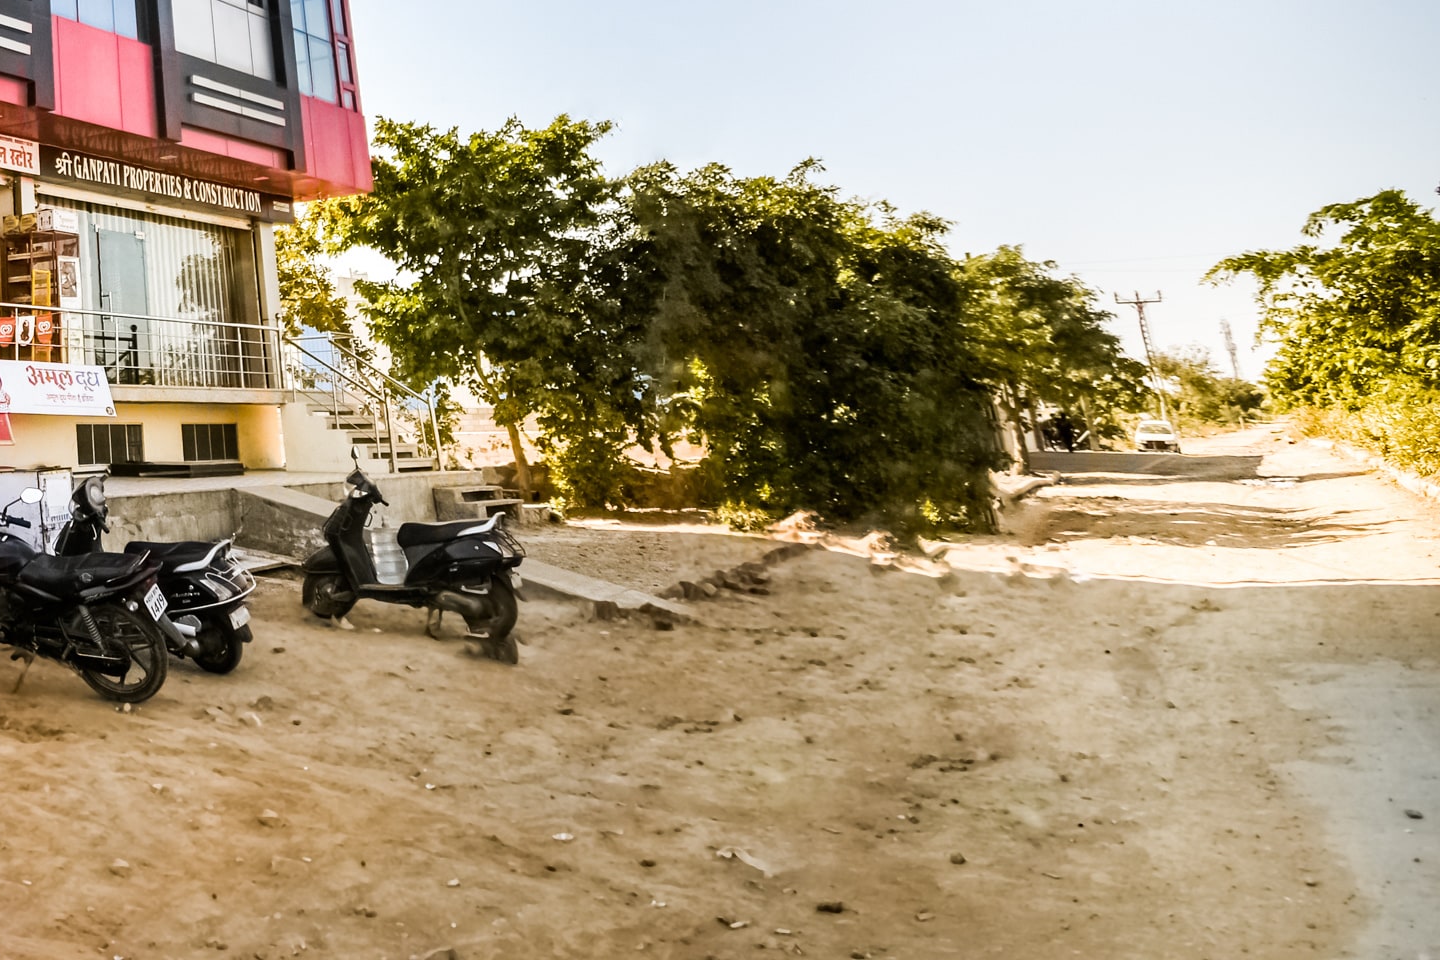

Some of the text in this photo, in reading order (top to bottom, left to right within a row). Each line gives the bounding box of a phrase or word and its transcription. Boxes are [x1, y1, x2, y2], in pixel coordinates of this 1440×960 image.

[10, 146, 35, 170] स्टोर
[54, 151, 73, 177] श्री
[73, 155, 121, 186] GANPATI
[123, 165, 183, 199] PROPERTIES
[184, 179, 193, 200] &
[193, 180, 262, 213] CONSTRUCTION
[25, 365, 101, 392] अमूल दूध
[150, 593, 166, 618] 1419
